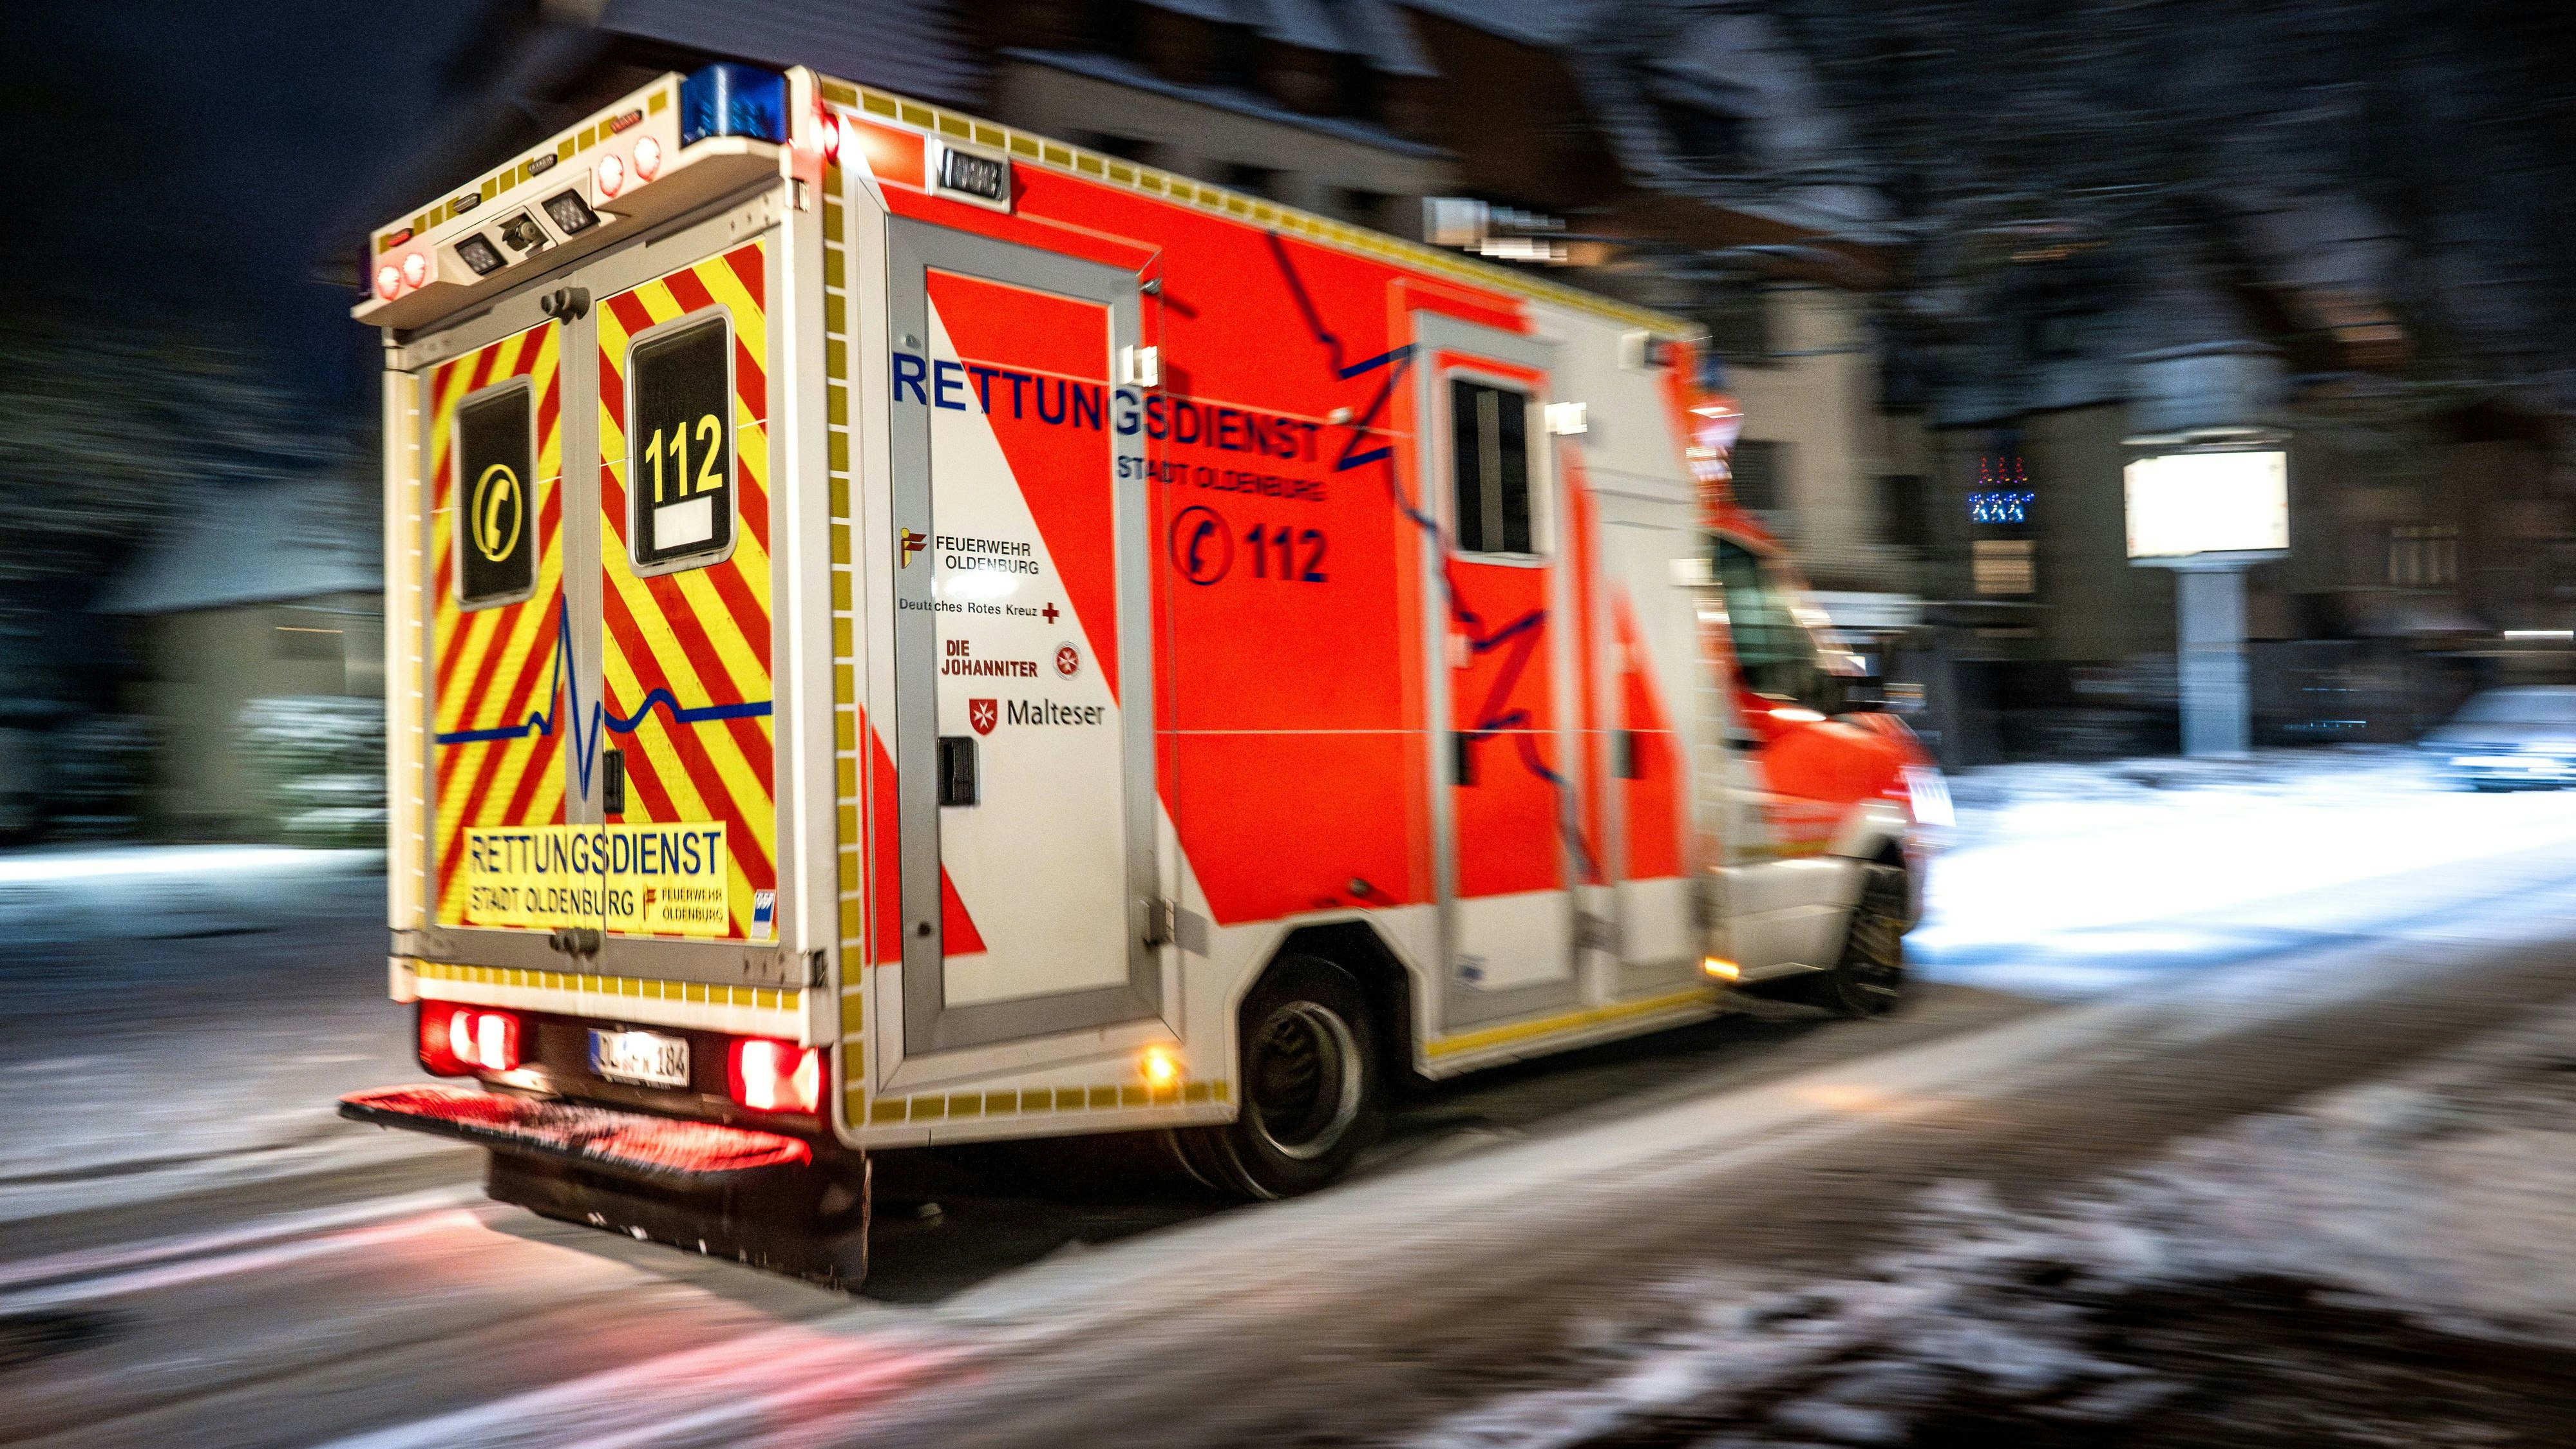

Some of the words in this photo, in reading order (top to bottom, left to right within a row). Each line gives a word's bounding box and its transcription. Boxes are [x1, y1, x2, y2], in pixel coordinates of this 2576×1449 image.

[893, 352, 1320, 462] RETTUNGSDIENST
[645, 414, 723, 503] 112
[1117, 455, 1188, 485] STADT
[936, 536, 1031, 556] FEUERWEHR
[1246, 523, 1329, 582] 112
[945, 555, 1039, 574] OLDENBURG
[899, 598, 963, 612] Deutsches
[968, 602, 1001, 615] Rotes
[1006, 604, 1037, 616] Kreuz
[946, 639, 970, 657] DIE
[942, 659, 1039, 677] JOHANNITER
[1007, 699, 1106, 726] Malteser
[472, 831, 722, 875] RETTUNGSDIENST
[526, 887, 634, 916] OLDENBURG
[661, 886, 723, 903] FEUERWEHR
[662, 905, 723, 922] OLDENBURG
[656, 1045, 687, 1077] 184
